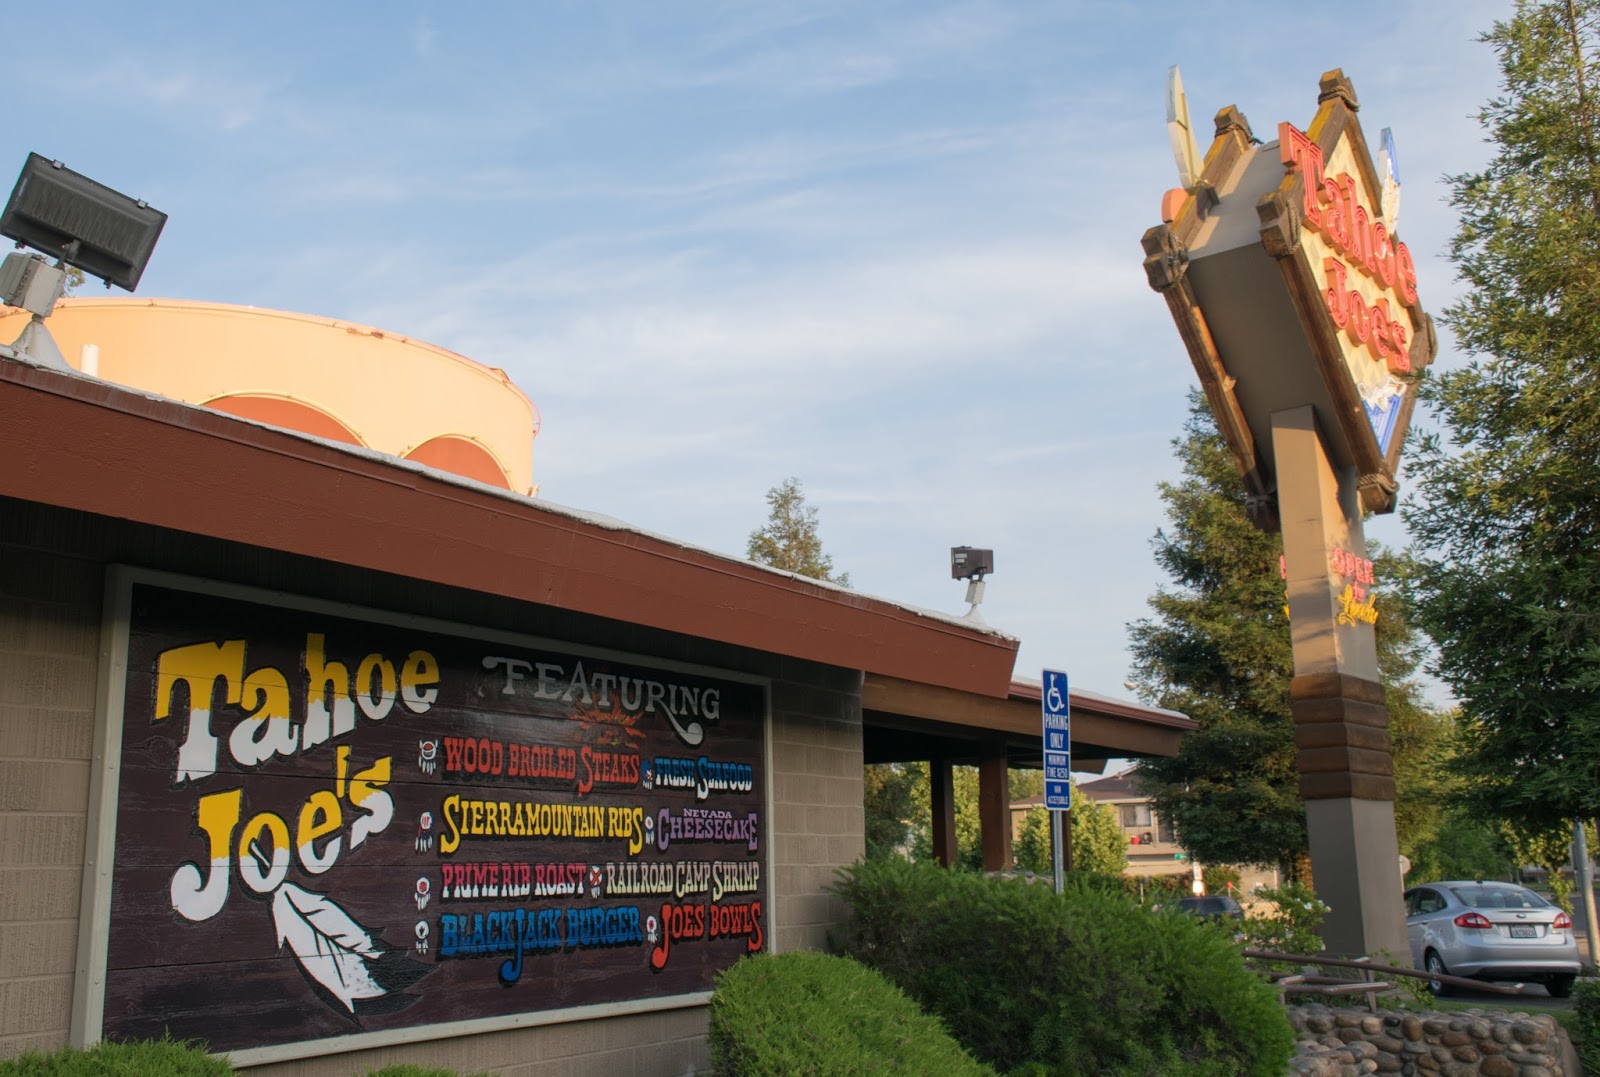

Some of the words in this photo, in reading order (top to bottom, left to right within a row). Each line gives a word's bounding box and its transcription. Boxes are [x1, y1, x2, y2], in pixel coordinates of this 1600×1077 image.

[1279, 122, 1417, 306] Tahoe
[1325, 257, 1411, 374] Joe's
[153, 632, 440, 784] Tahoe
[482, 656, 720, 745] FEATURING
[1045, 713, 1068, 730] PARKING
[1050, 732, 1064, 749] ONLY
[443, 737, 502, 775] WOOD
[507, 744, 577, 780] BROILED
[577, 745, 640, 797] STEAKS
[654, 757, 696, 786] FRESH
[697, 757, 753, 799] SEAFOOD
[1046, 767, 1057, 777] FINE
[1057, 768, 1068, 779] $250
[170, 745, 395, 922] Joe's
[608, 807, 643, 856] RIBS
[657, 808, 758, 851] CHEESECAKE
[683, 808, 732, 818] NEVADA
[442, 863, 498, 898] PRIME
[501, 863, 531, 896] RIB
[534, 863, 587, 895] ROAST
[606, 862, 674, 894] RAILROAD
[675, 861, 711, 898] CAMP
[712, 861, 760, 902] SHRIMP
[566, 906, 643, 947] BURGER
[652, 904, 705, 968] JOES
[710, 902, 763, 951] BOWLS
